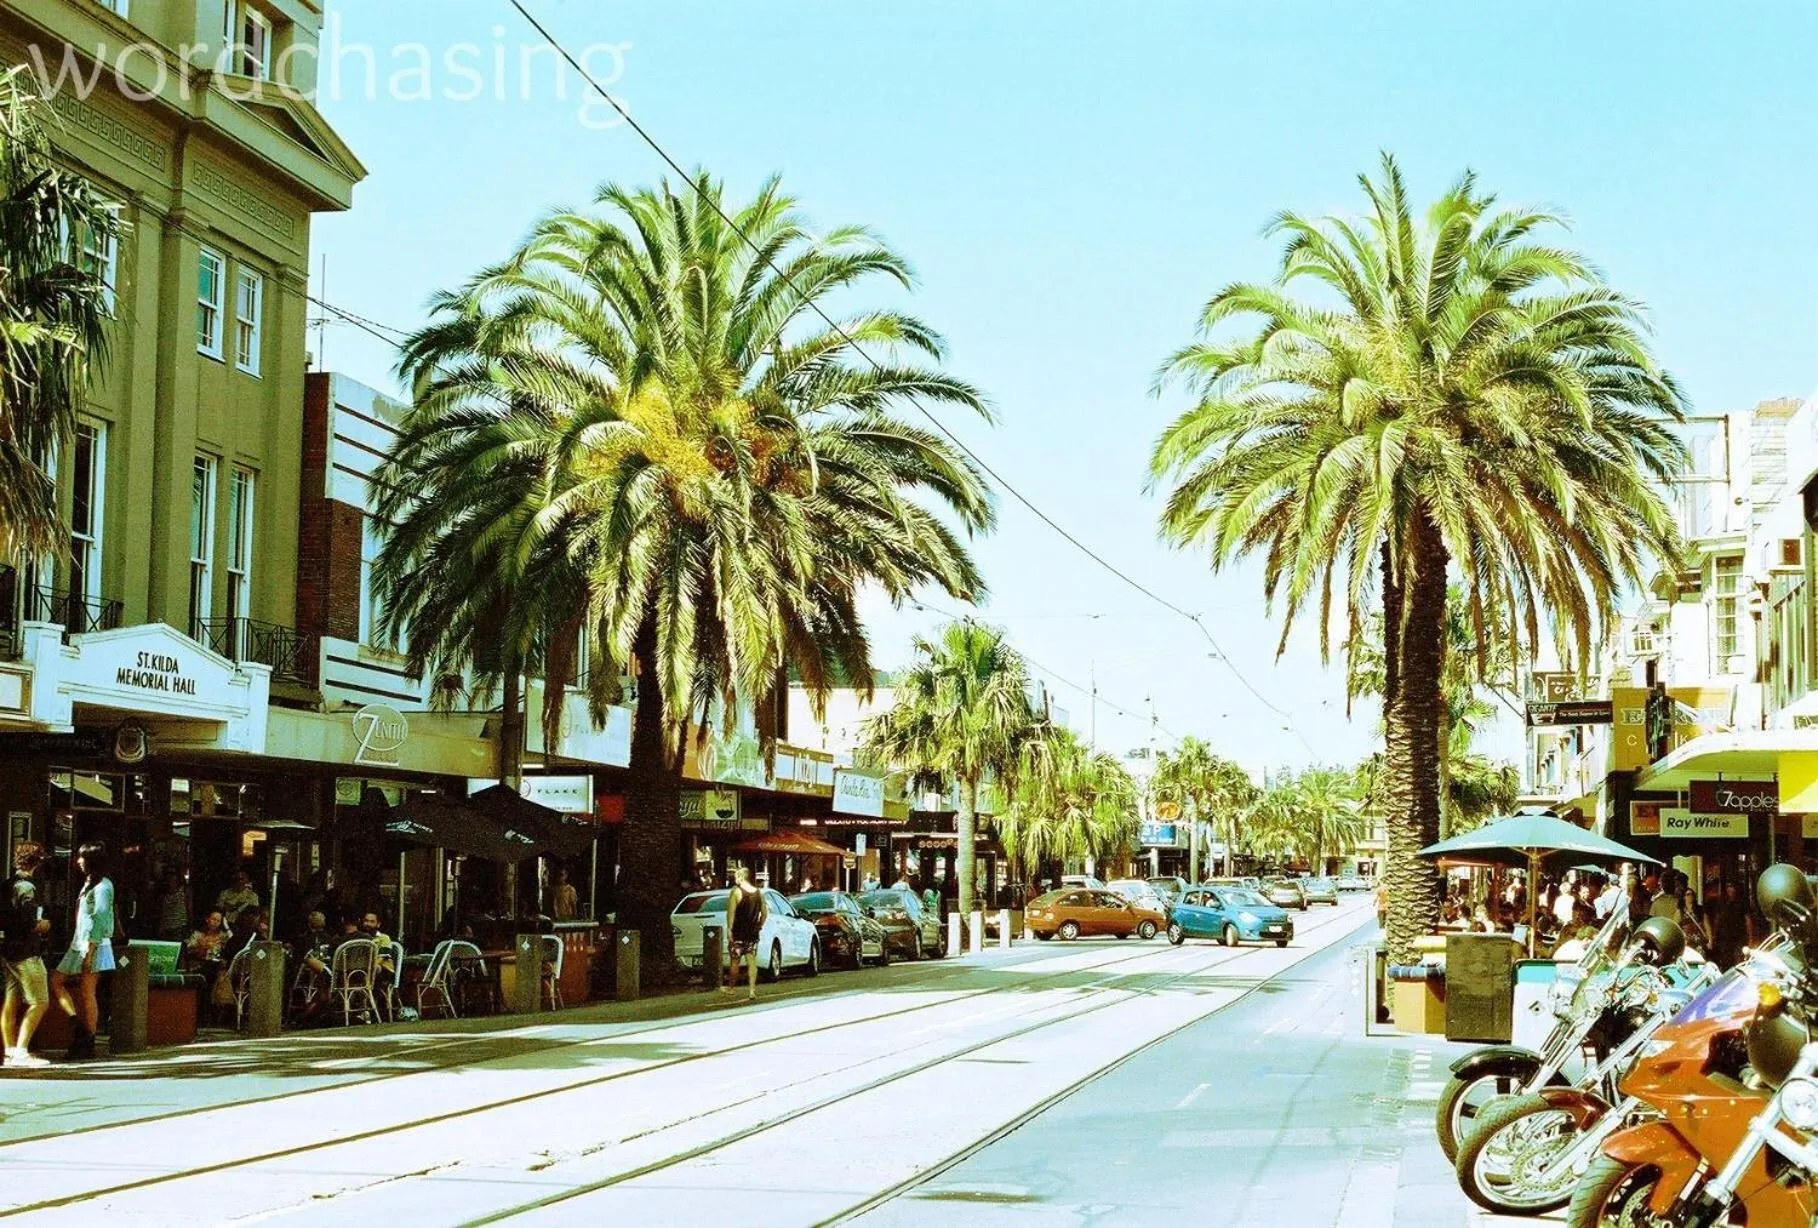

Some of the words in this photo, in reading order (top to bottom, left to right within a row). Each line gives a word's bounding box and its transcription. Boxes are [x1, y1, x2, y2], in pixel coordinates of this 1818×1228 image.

[116, 667, 169, 691] MEMORIAL
[172, 676, 196, 695] HALL
[1667, 817, 1691, 829] Ray
